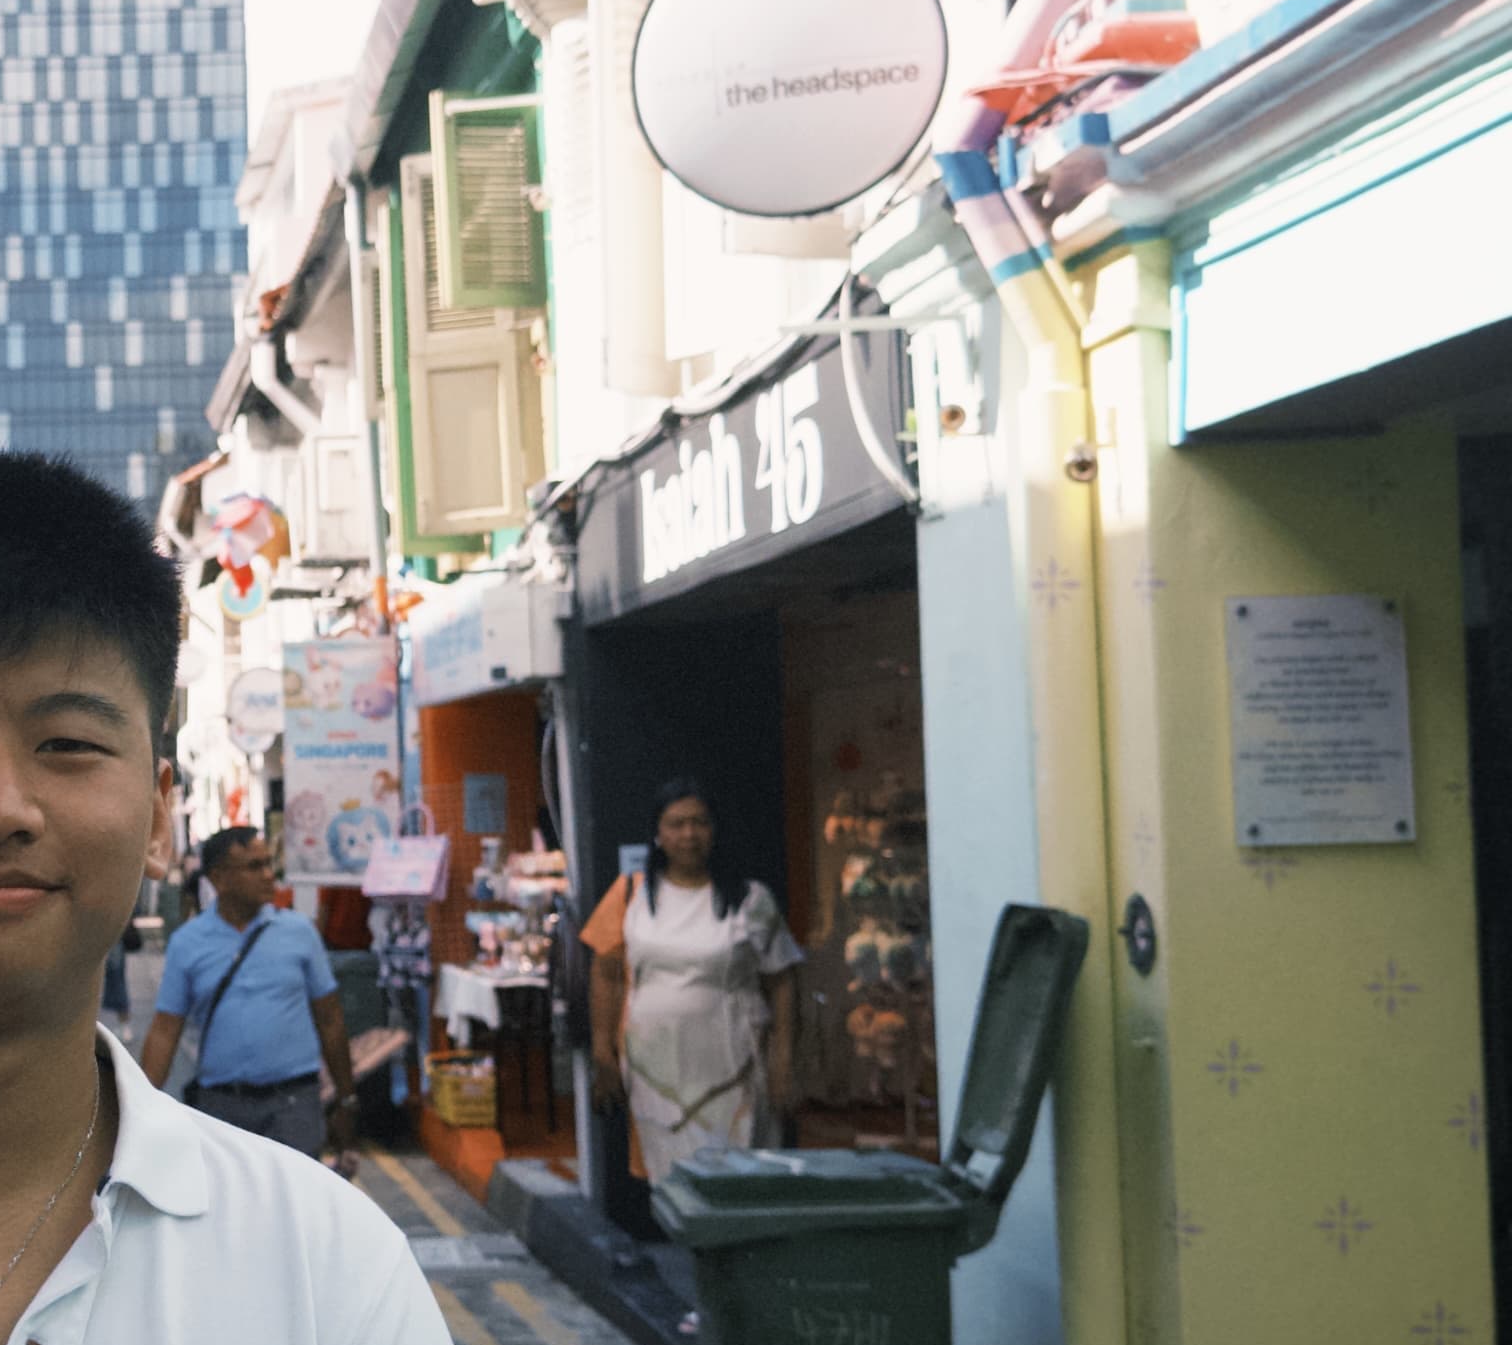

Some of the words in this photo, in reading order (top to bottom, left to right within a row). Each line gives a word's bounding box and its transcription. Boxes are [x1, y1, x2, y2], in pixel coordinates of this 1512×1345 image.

[725, 83, 769, 106] the
[771, 62, 920, 103] headspace
[640, 412, 748, 584] Isaiah
[754, 359, 824, 534] 45
[295, 743, 389, 761] SINGAPORE
